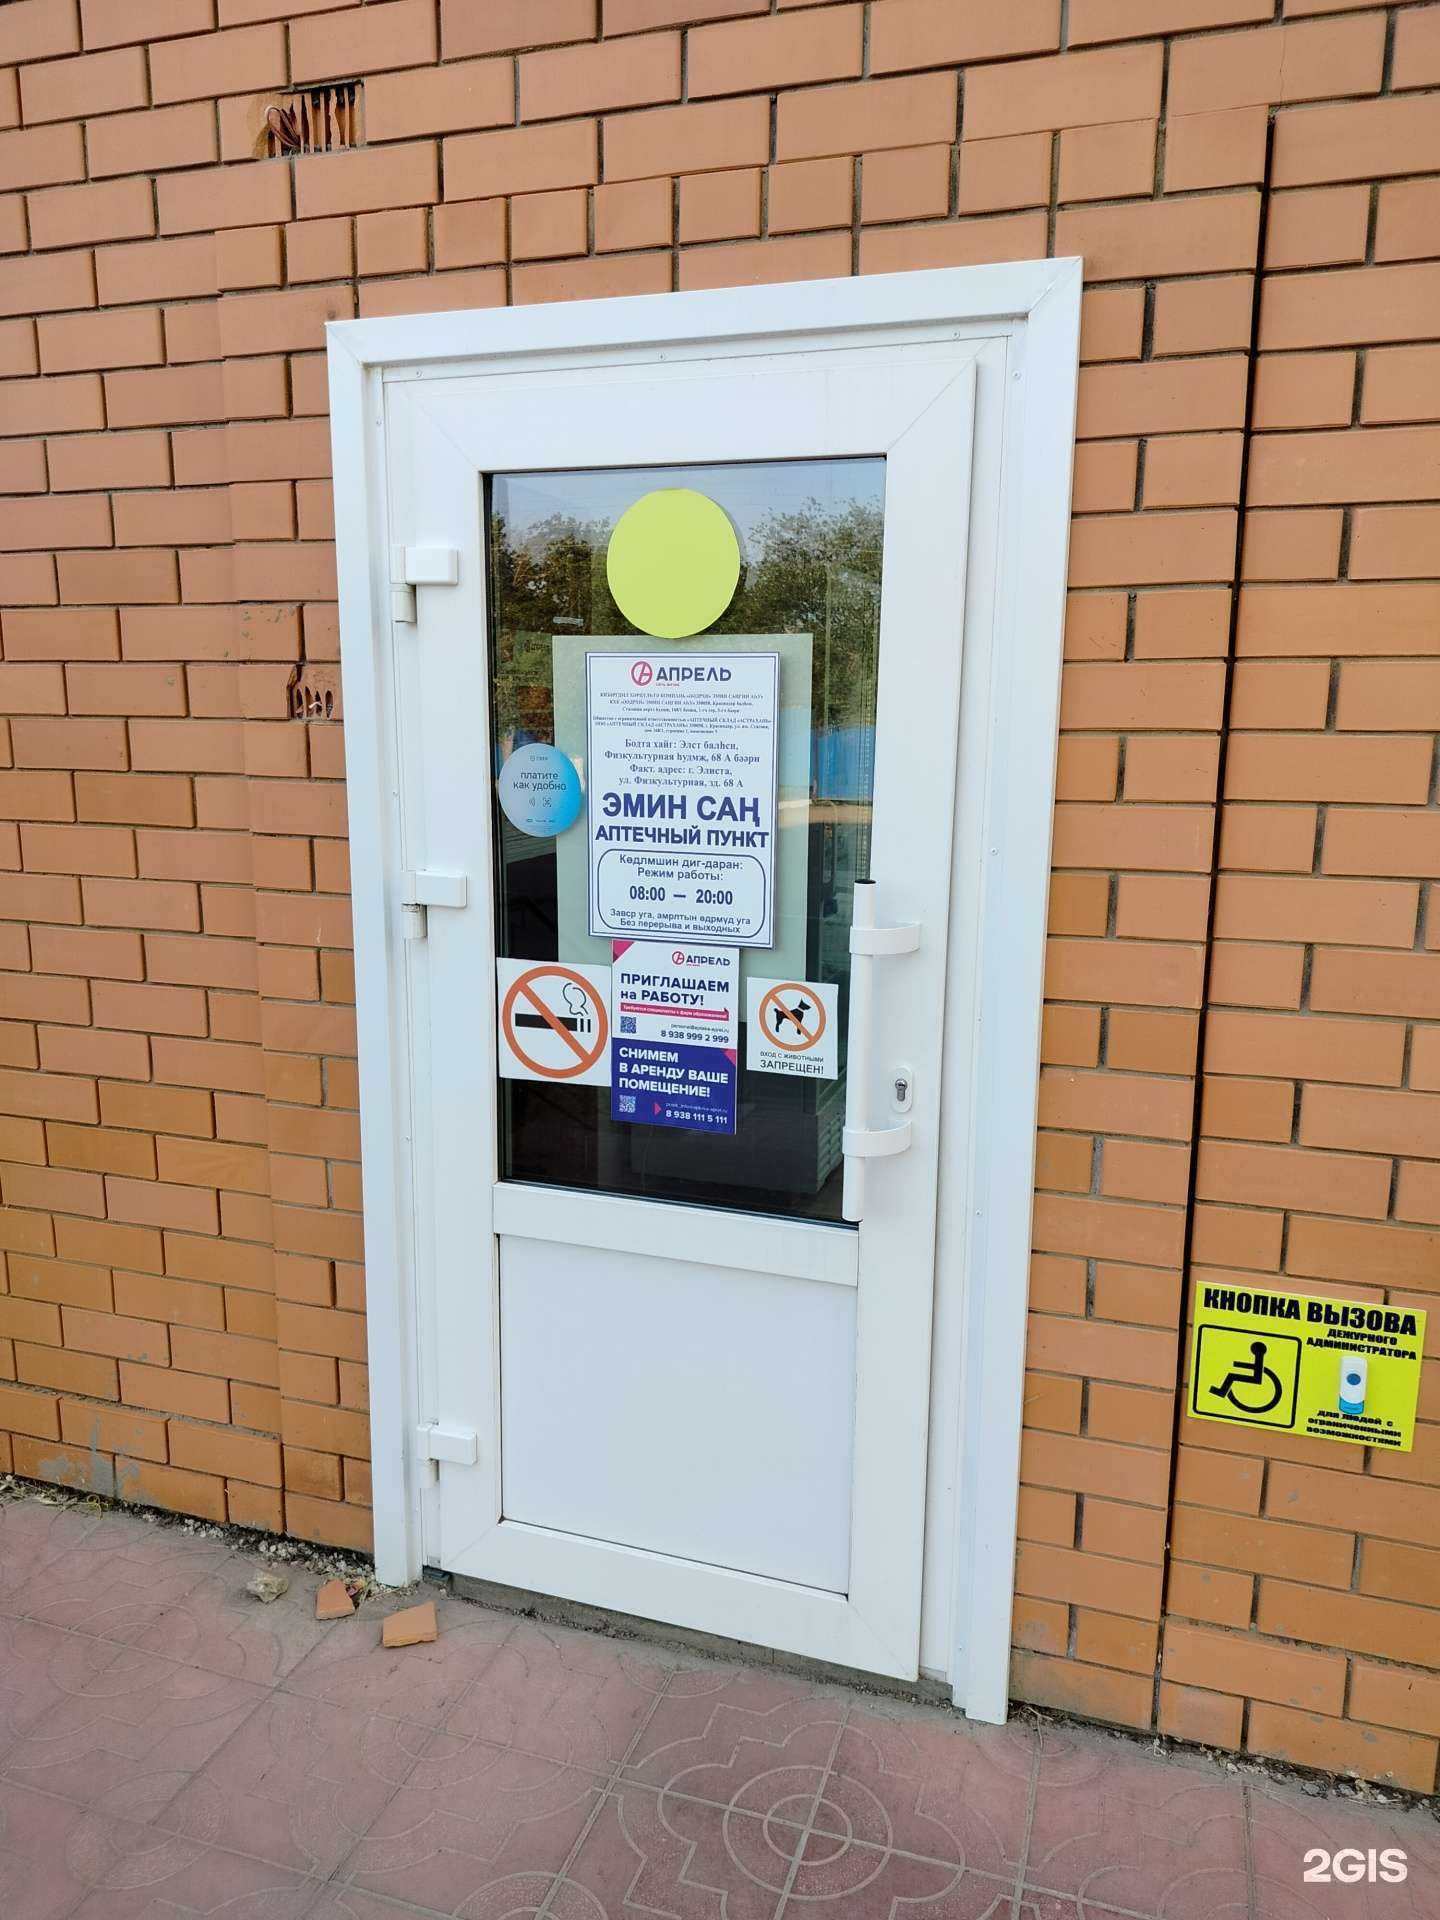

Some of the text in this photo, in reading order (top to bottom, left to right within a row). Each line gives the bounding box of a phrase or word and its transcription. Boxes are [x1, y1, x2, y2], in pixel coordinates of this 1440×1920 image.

[656, 666, 732, 682] АПРЕЛЬ
[605, 752, 675, 764] Физкультурная
[711, 754, 721, 762] 68
[724, 754, 732, 762] А
[520, 772, 559, 780] платите
[630, 764, 654, 773] Факт.
[657, 766, 685, 776] адрес:
[698, 766, 732, 777] Элиста,
[513, 780, 566, 791] как удобно
[618, 778, 632, 786] ул.
[634, 776, 707, 787] Физкультурная,
[723, 778, 734, 787] 68
[602, 792, 687, 820] ЭМИН
[595, 825, 769, 848] АПТЕЧНЫЙ ПУНКТ
[682, 858, 743, 869] диг-даран:
[638, 867, 723, 881] Режим работы:
[629, 885, 666, 901] 08:00
[696, 889, 733, 905] 20:00
[620, 918, 636, 926] Без
[638, 920, 682, 930] перерыва
[693, 922, 740, 933] выходных
[657, 912, 697, 921] амрлтын
[736, 916, 751, 925] уга
[686, 955, 730, 966] АПРЕЛЬ
[620, 973, 729, 992] ПРИГЛАШАЕМ
[620, 990, 704, 1005] на РАБОТУ!
[668, 1031, 684, 1039] 938
[686, 1032, 702, 1040] 999
[705, 1034, 710, 1042] 2
[713, 1035, 729, 1043] 999
[619, 1047, 679, 1062] СНИМЕМ
[619, 1062, 728, 1084] В АРЕНДУ ВАШЕ
[760, 1060, 824, 1074] ЗАПРЕЩЕН!
[619, 1078, 710, 1097] ПОМЕЩЕНИЕ!
[665, 1110, 727, 1124] 8 938 111 5 111
[1204, 1288, 1417, 1336] КНОПКА ВЫЗОВА
[1326, 1328, 1398, 1346] ДЕЖУРНОГО
[1306, 1337, 1417, 1360] АДМИНИСТРАТОРА
